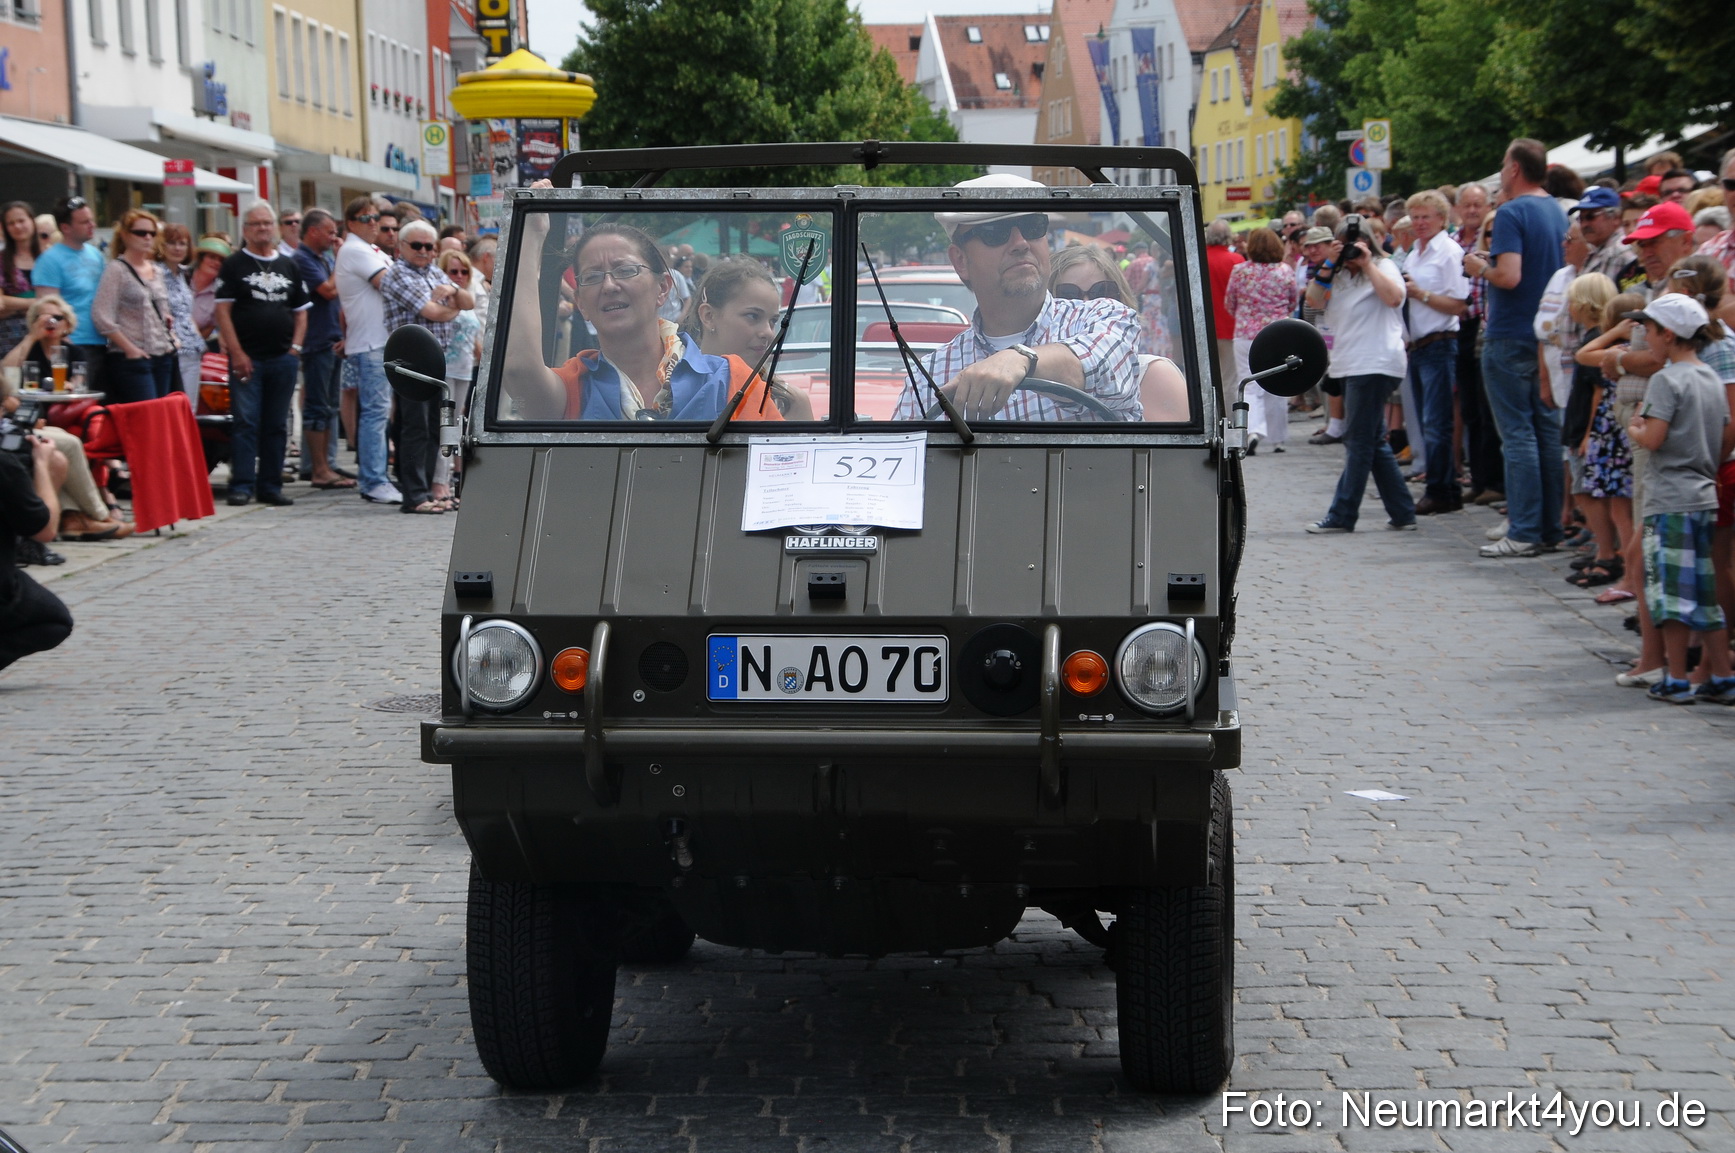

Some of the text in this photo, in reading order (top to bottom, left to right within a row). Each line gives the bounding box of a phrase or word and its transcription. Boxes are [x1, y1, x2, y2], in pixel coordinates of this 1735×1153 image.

[785, 231, 822, 241] JAGDSCHUTZ
[833, 456, 903, 480] 527
[788, 537, 875, 548] HAFLINGER
[741, 645, 942, 693] N AO 70
[718, 675, 729, 688] D
